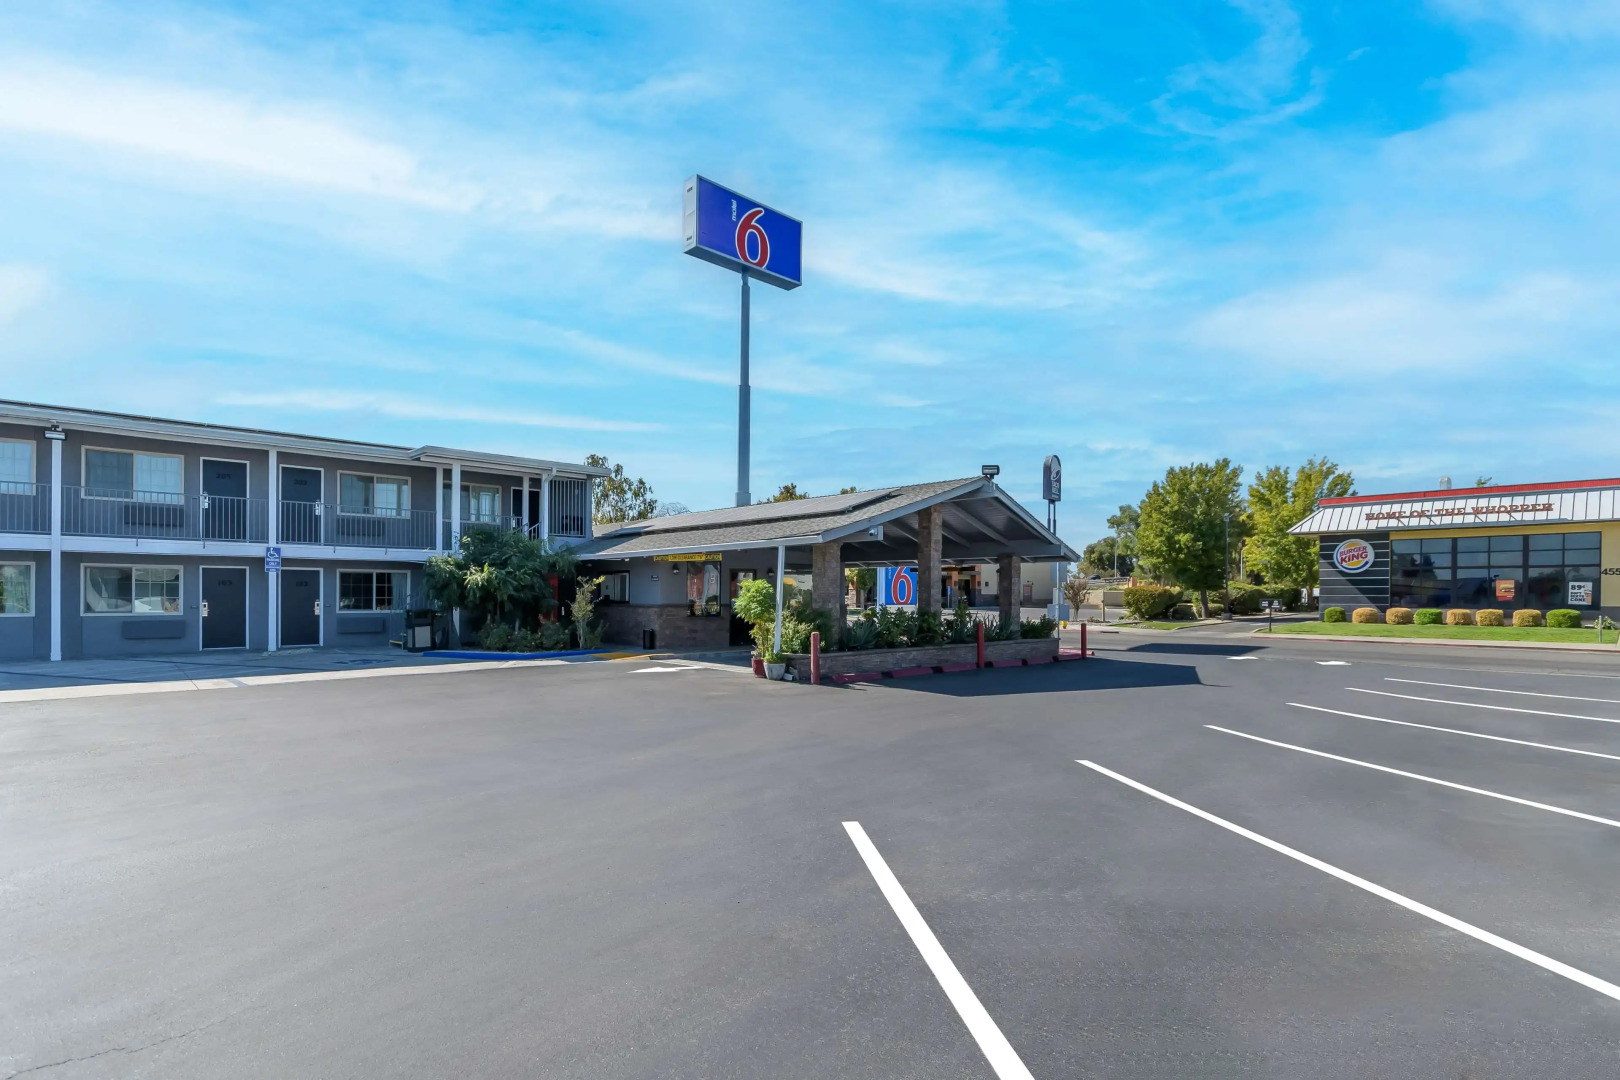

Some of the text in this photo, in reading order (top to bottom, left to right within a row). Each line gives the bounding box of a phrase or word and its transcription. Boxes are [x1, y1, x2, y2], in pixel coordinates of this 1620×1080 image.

[735, 208, 770, 270] 6
[1365, 503, 1555, 521] HOME OF THE WHOPPER
[1340, 545, 1368, 557] BURGER
[1340, 552, 1369, 565] KING
[892, 566, 913, 604] 6
